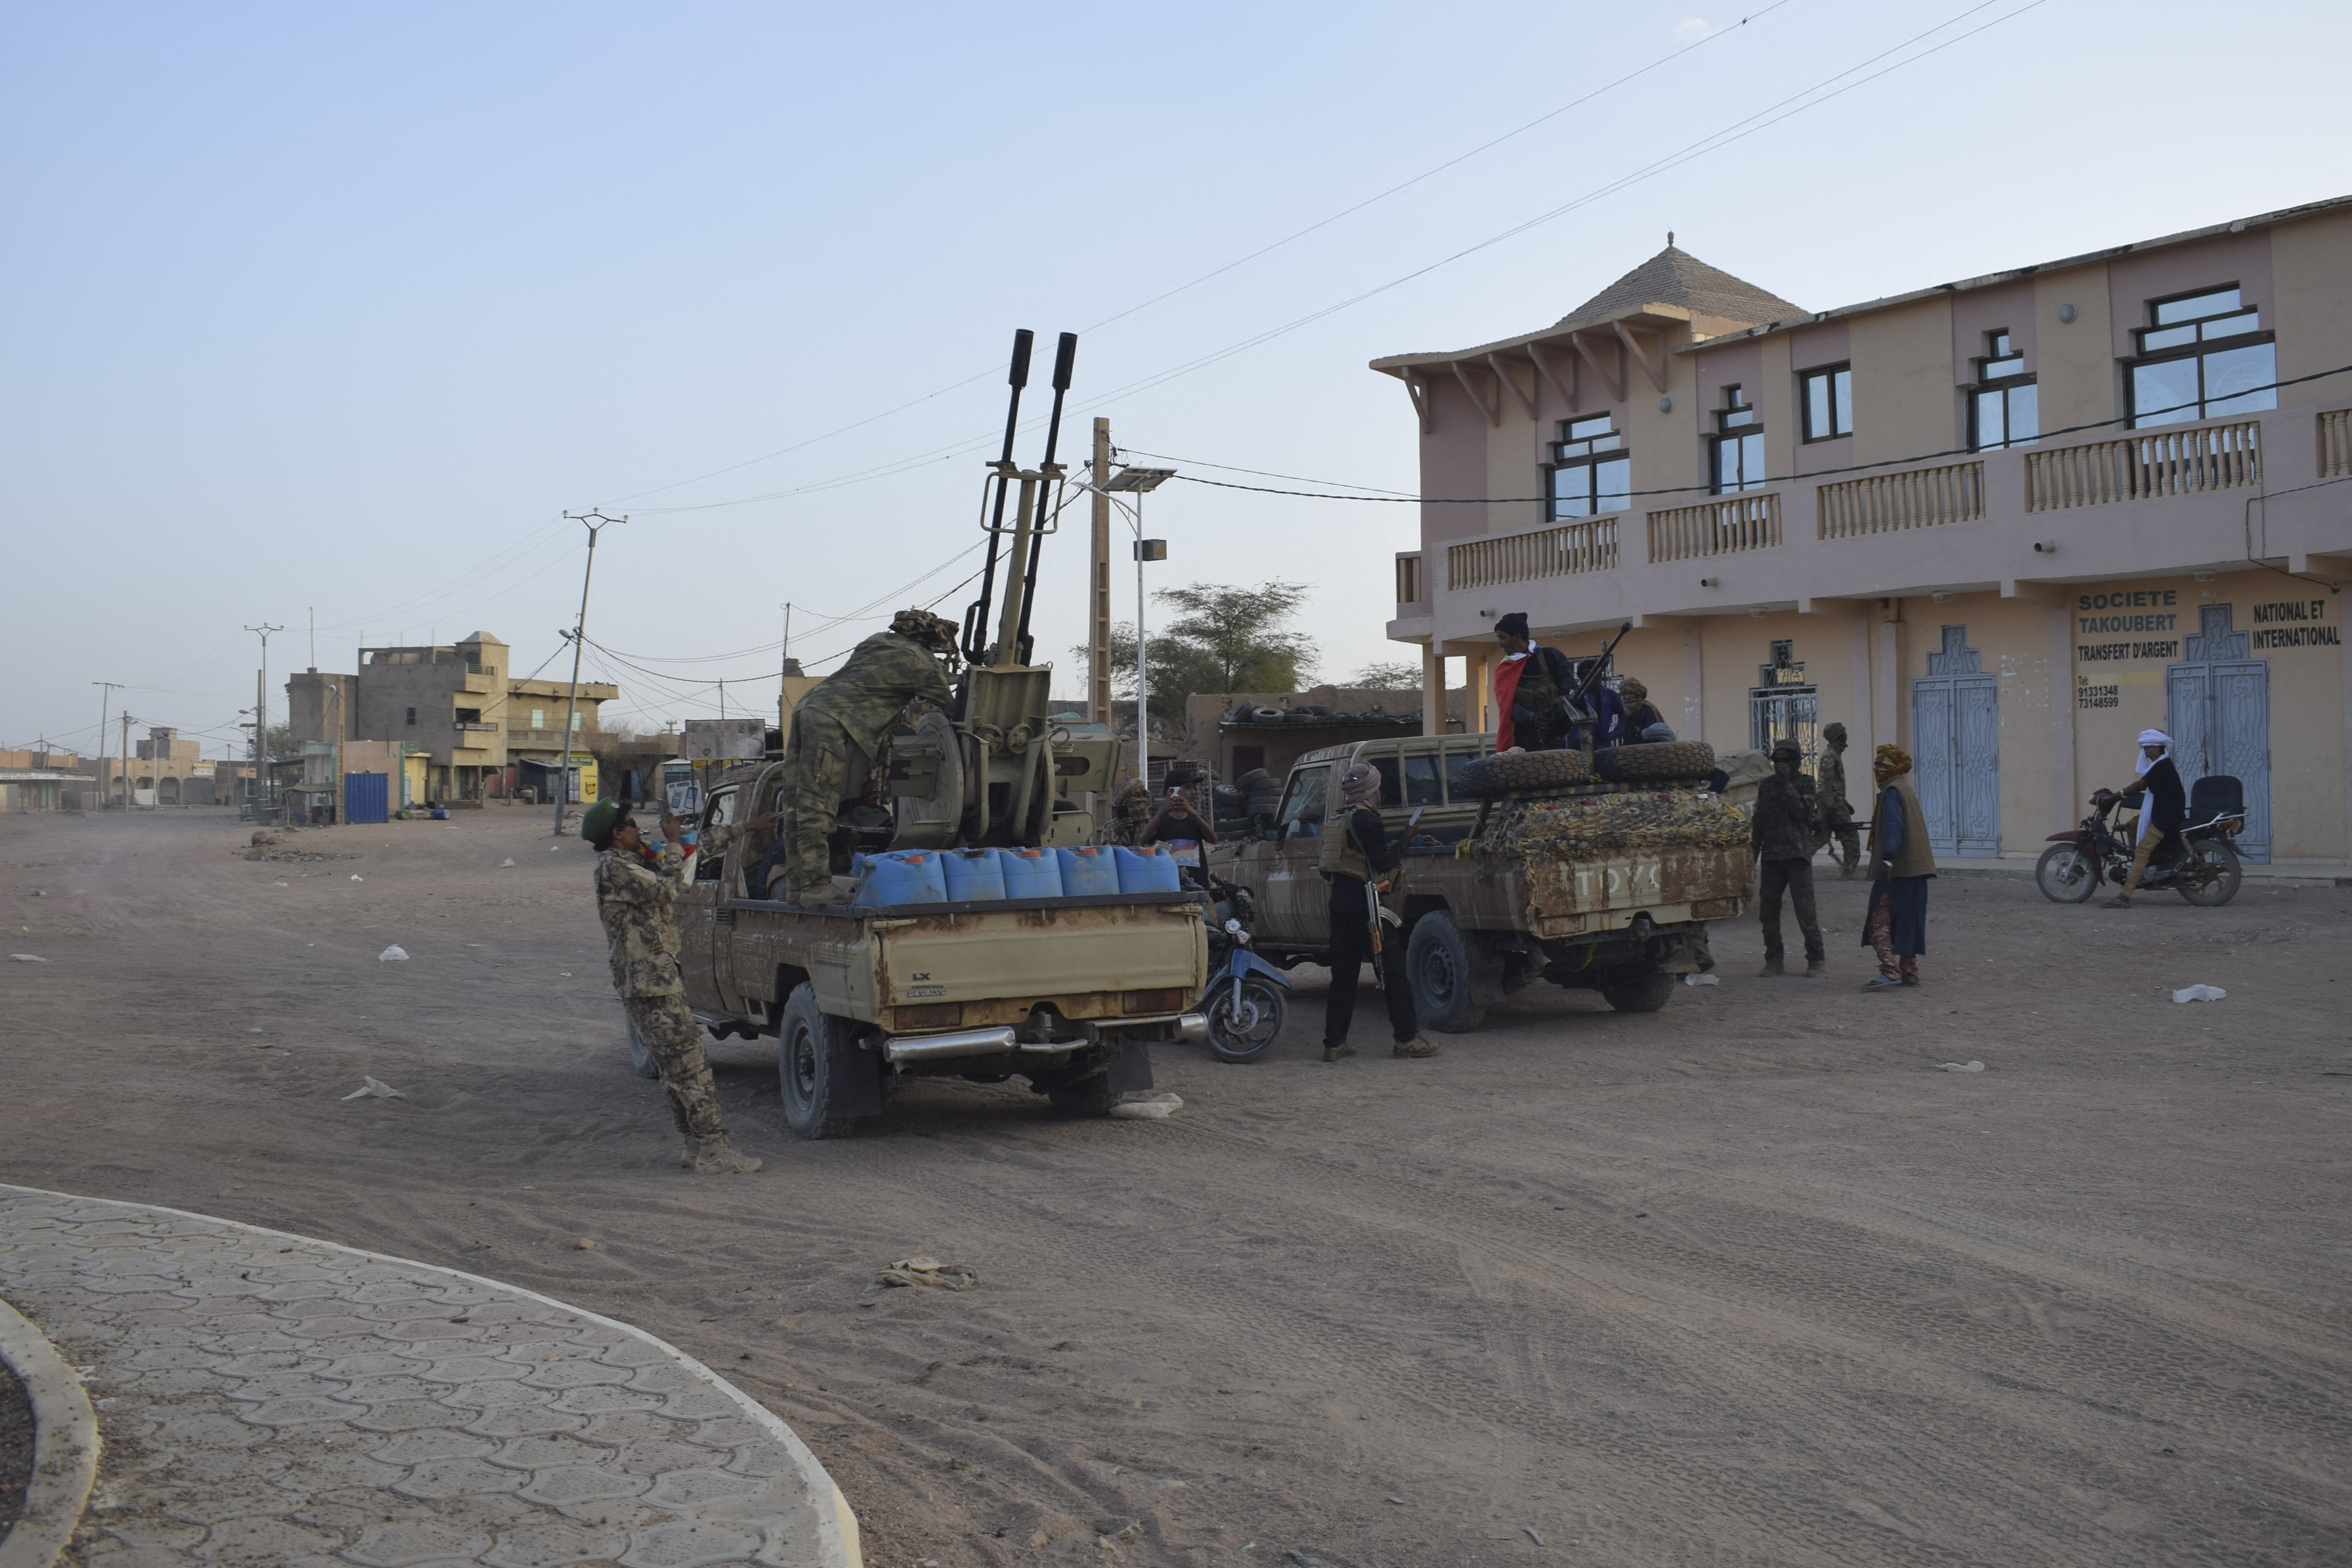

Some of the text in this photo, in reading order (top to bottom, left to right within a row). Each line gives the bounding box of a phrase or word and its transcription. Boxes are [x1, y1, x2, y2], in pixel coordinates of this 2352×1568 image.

[2079, 590, 2177, 610] SOCIETE
[2253, 600, 2325, 623] NATIONAL ET
[2079, 614, 2177, 634] TAKOUBERT
[2253, 626, 2340, 649] INTERNATIONAL
[2078, 641, 2178, 661] TRANSFERT D'ARGENT
[2078, 685, 2118, 697] 91331348
[2078, 697, 2118, 709] 73148599
[1576, 860, 1676, 896] TOYO
[912, 972, 931, 981] LX
